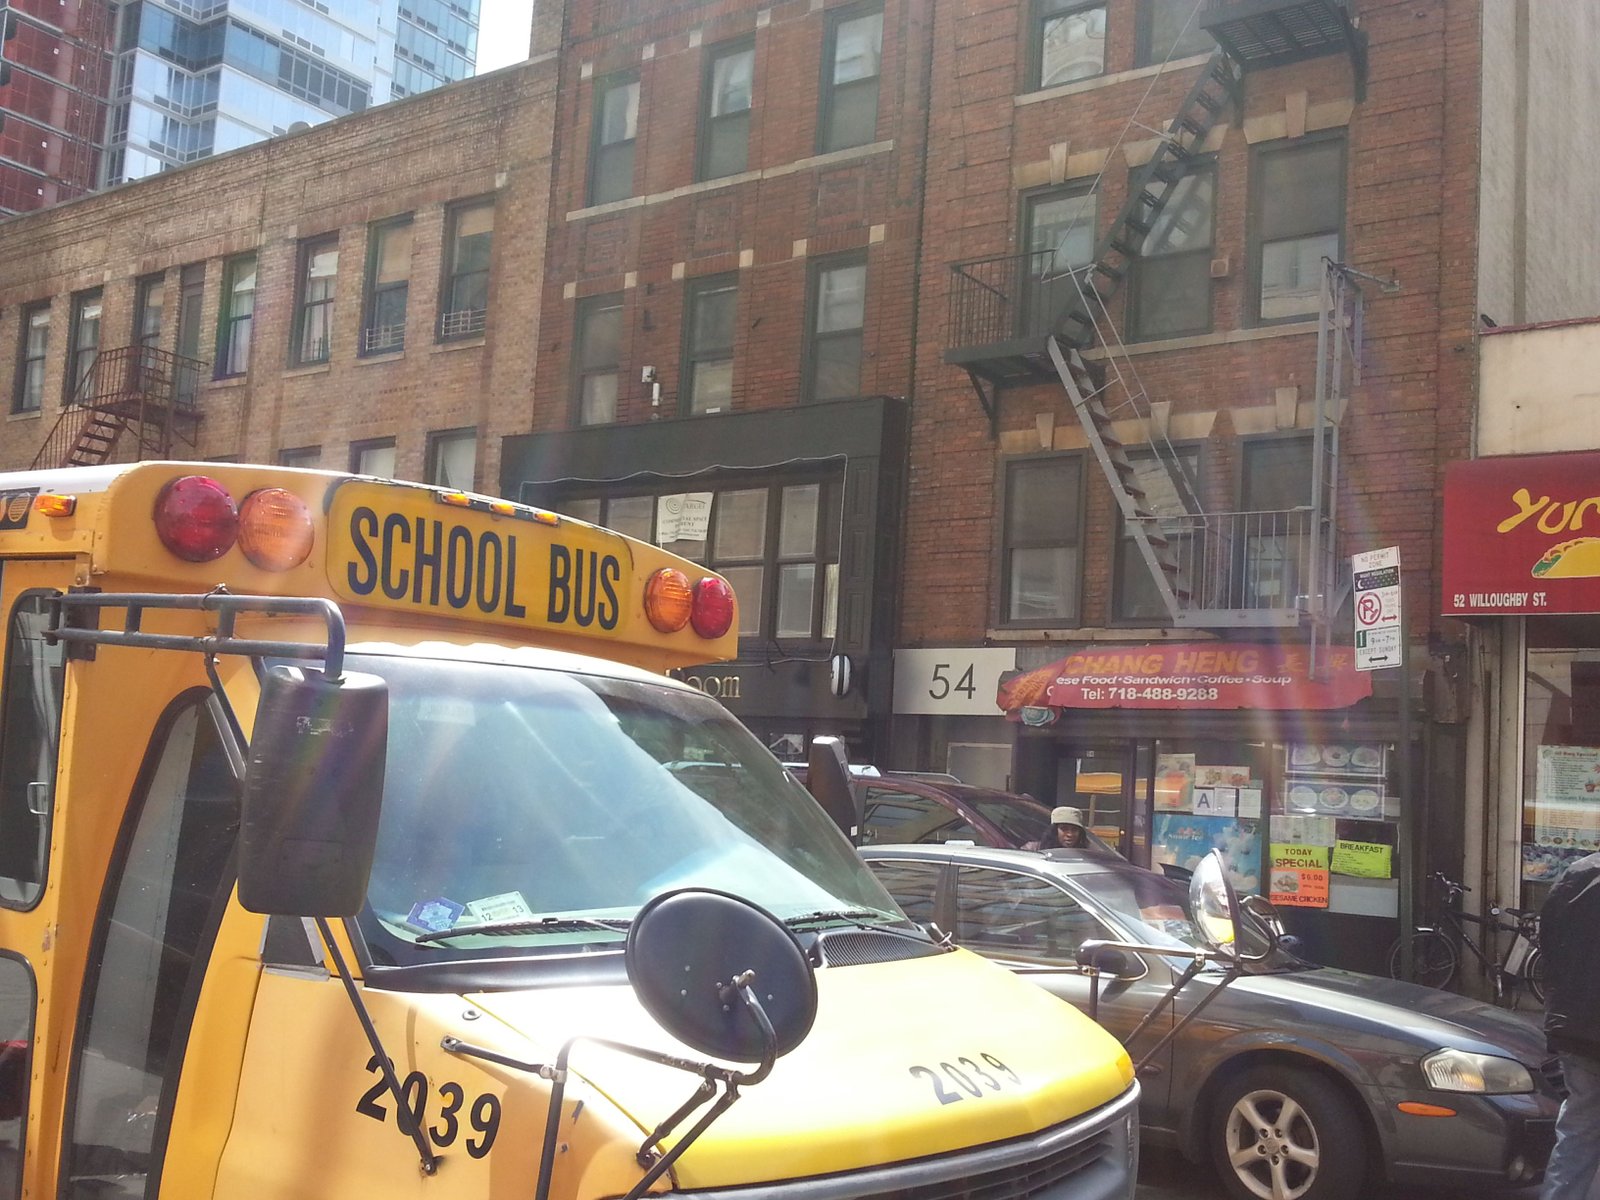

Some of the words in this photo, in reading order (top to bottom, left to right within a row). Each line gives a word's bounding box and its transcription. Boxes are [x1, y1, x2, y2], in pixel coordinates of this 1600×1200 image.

[348, 506, 526, 618] SCHOOL
[547, 543, 620, 631] BUS
[1453, 594, 1466, 608] 52
[1469, 592, 1529, 607] WILLOUGHBY
[1532, 592, 1548, 606] ST.
[1065, 654, 1164, 674] CHANG
[1173, 650, 1261, 673] HENG
[928, 663, 976, 699] 54
[1123, 676, 1190, 685] Sandwich
[1251, 675, 1292, 686] Soup
[1081, 688, 1105, 700] Tel:
[1108, 687, 1218, 700] 718-488-9288
[1197, 793, 1210, 808] A
[1285, 848, 1313, 856] TODAY
[1340, 842, 1384, 854] BREAKFAST
[1275, 858, 1323, 868] SPECIAL
[481, 912, 493, 922] 12
[909, 1052, 1022, 1106] 2039
[356, 1055, 501, 1160] 2039
